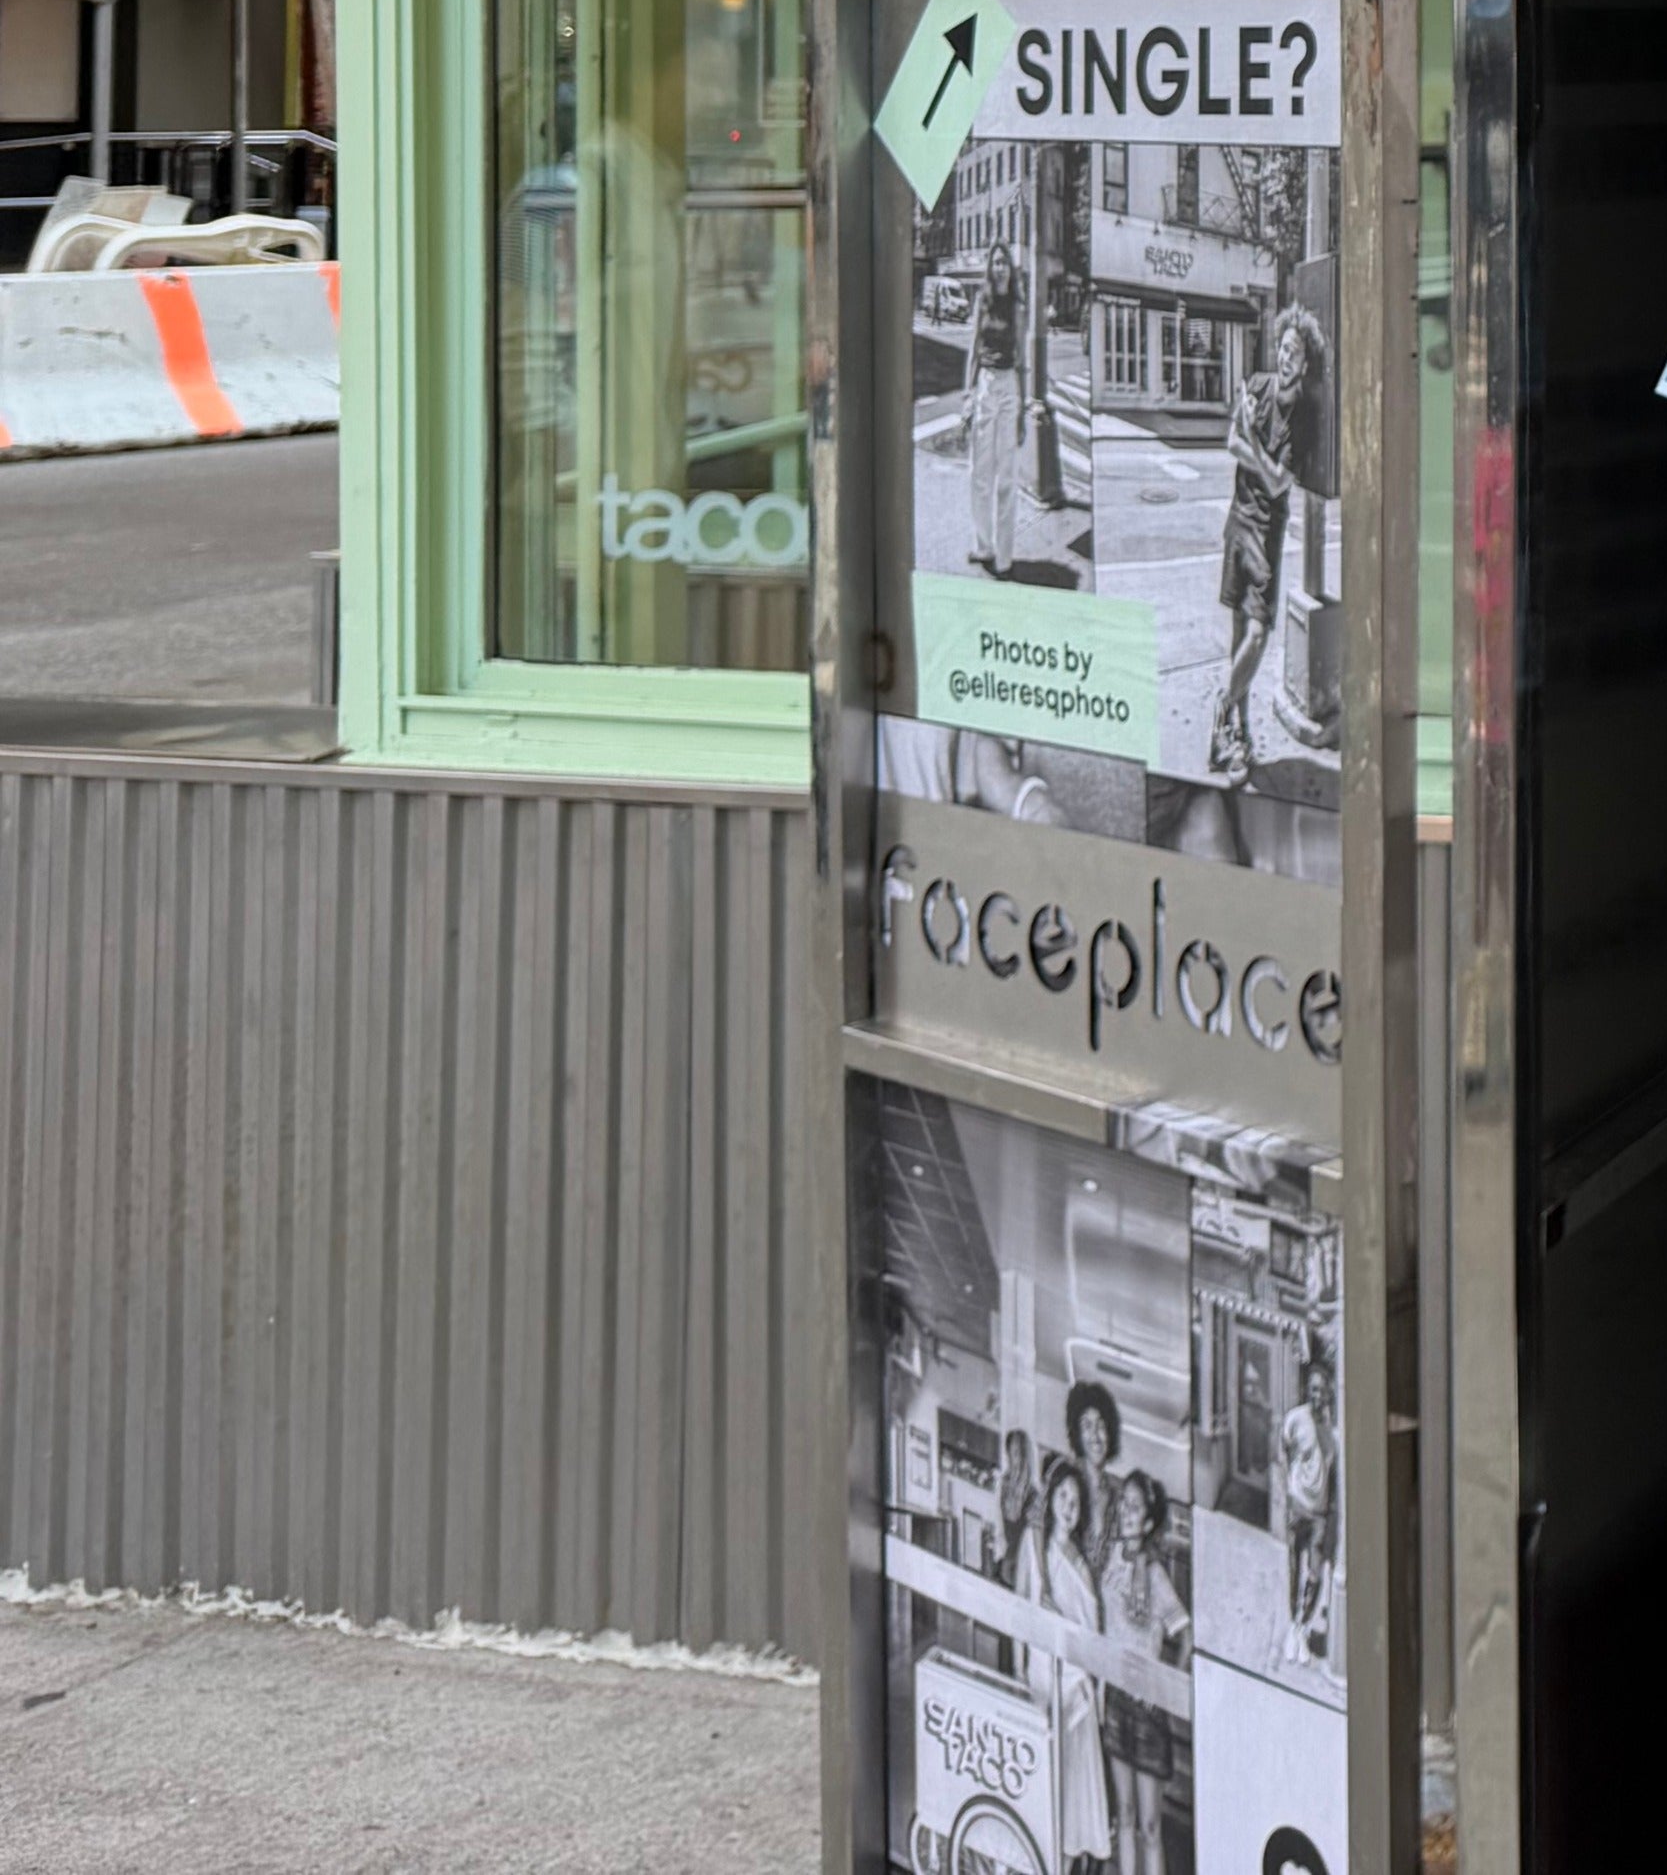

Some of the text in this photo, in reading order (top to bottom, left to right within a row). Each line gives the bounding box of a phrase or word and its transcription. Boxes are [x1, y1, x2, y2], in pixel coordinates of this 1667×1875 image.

[1016, 20, 1318, 117] SINGLE?
[596, 472, 810, 567] taco
[979, 631, 1094, 681] Photos by
[948, 670, 1131, 723] @elleresqphoto
[880, 842, 1343, 1066] faceplace
[922, 1696, 1038, 1775] SANTO
[941, 1735, 1026, 1800] TACO
